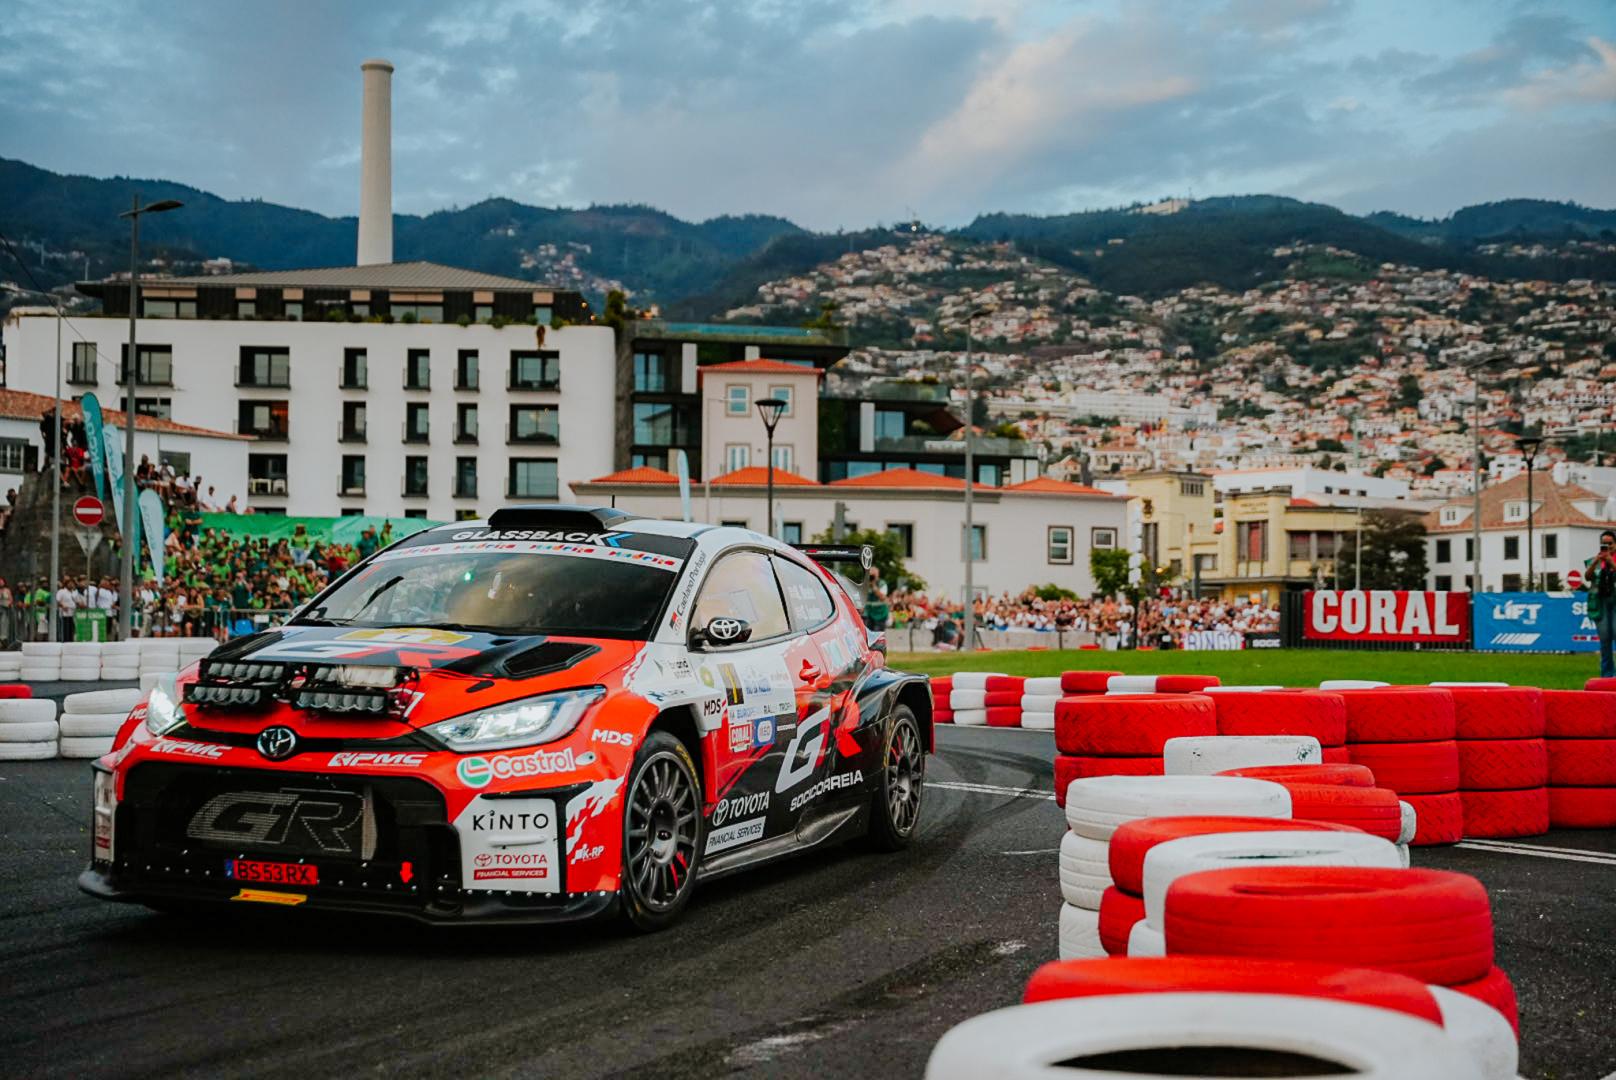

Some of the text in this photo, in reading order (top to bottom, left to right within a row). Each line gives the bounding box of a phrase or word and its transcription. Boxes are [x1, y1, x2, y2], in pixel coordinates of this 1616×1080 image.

[452, 530, 605, 546] GLASSBACK
[1312, 590, 1460, 635] CORAL
[703, 698, 722, 717] MDS
[591, 729, 634, 746] MDS
[491, 747, 577, 778] Castrol
[729, 791, 770, 819] TOYOTA
[708, 822, 763, 848] FINANCIAL SERVICES
[494, 854, 548, 865] TOYOTA
[476, 868, 545, 878] FINANCIAL SERVICES
